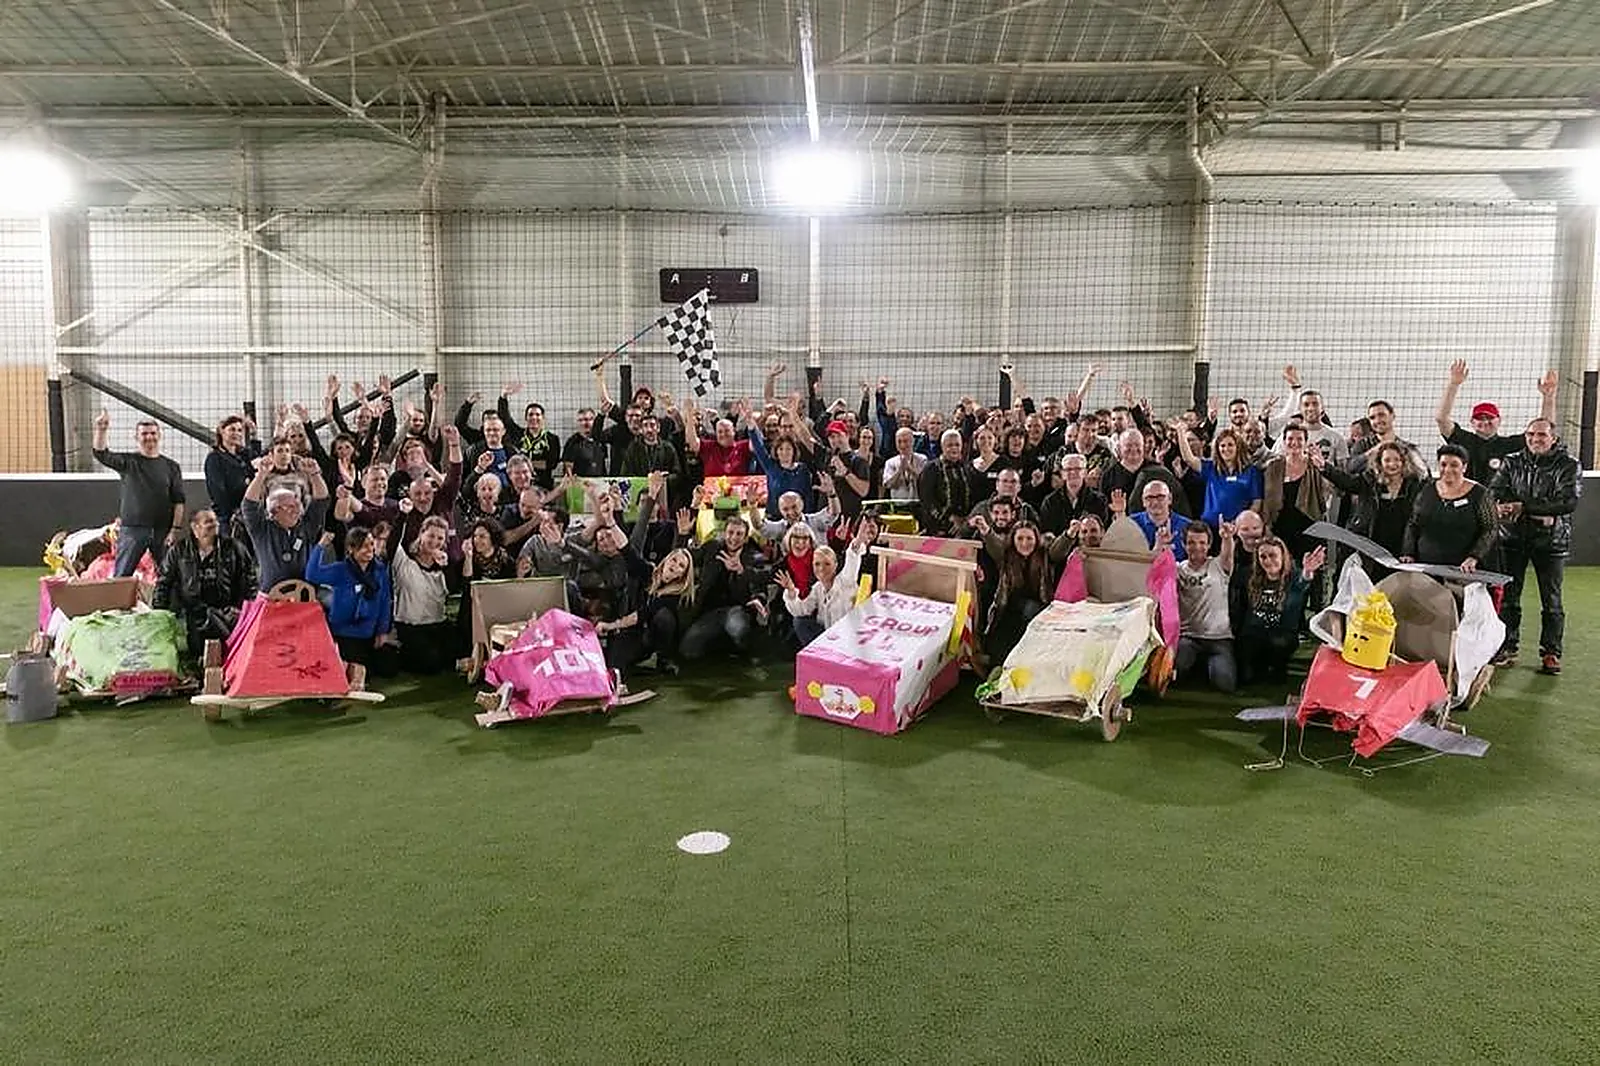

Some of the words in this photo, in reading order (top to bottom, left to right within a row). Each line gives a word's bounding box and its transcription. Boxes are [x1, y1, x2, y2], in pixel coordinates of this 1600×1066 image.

[670, 272, 680, 284] A
[740, 272, 749, 283] B
[864, 615, 940, 636] GROUP
[276, 642, 297, 668] 3
[532, 647, 591, 677] 10
